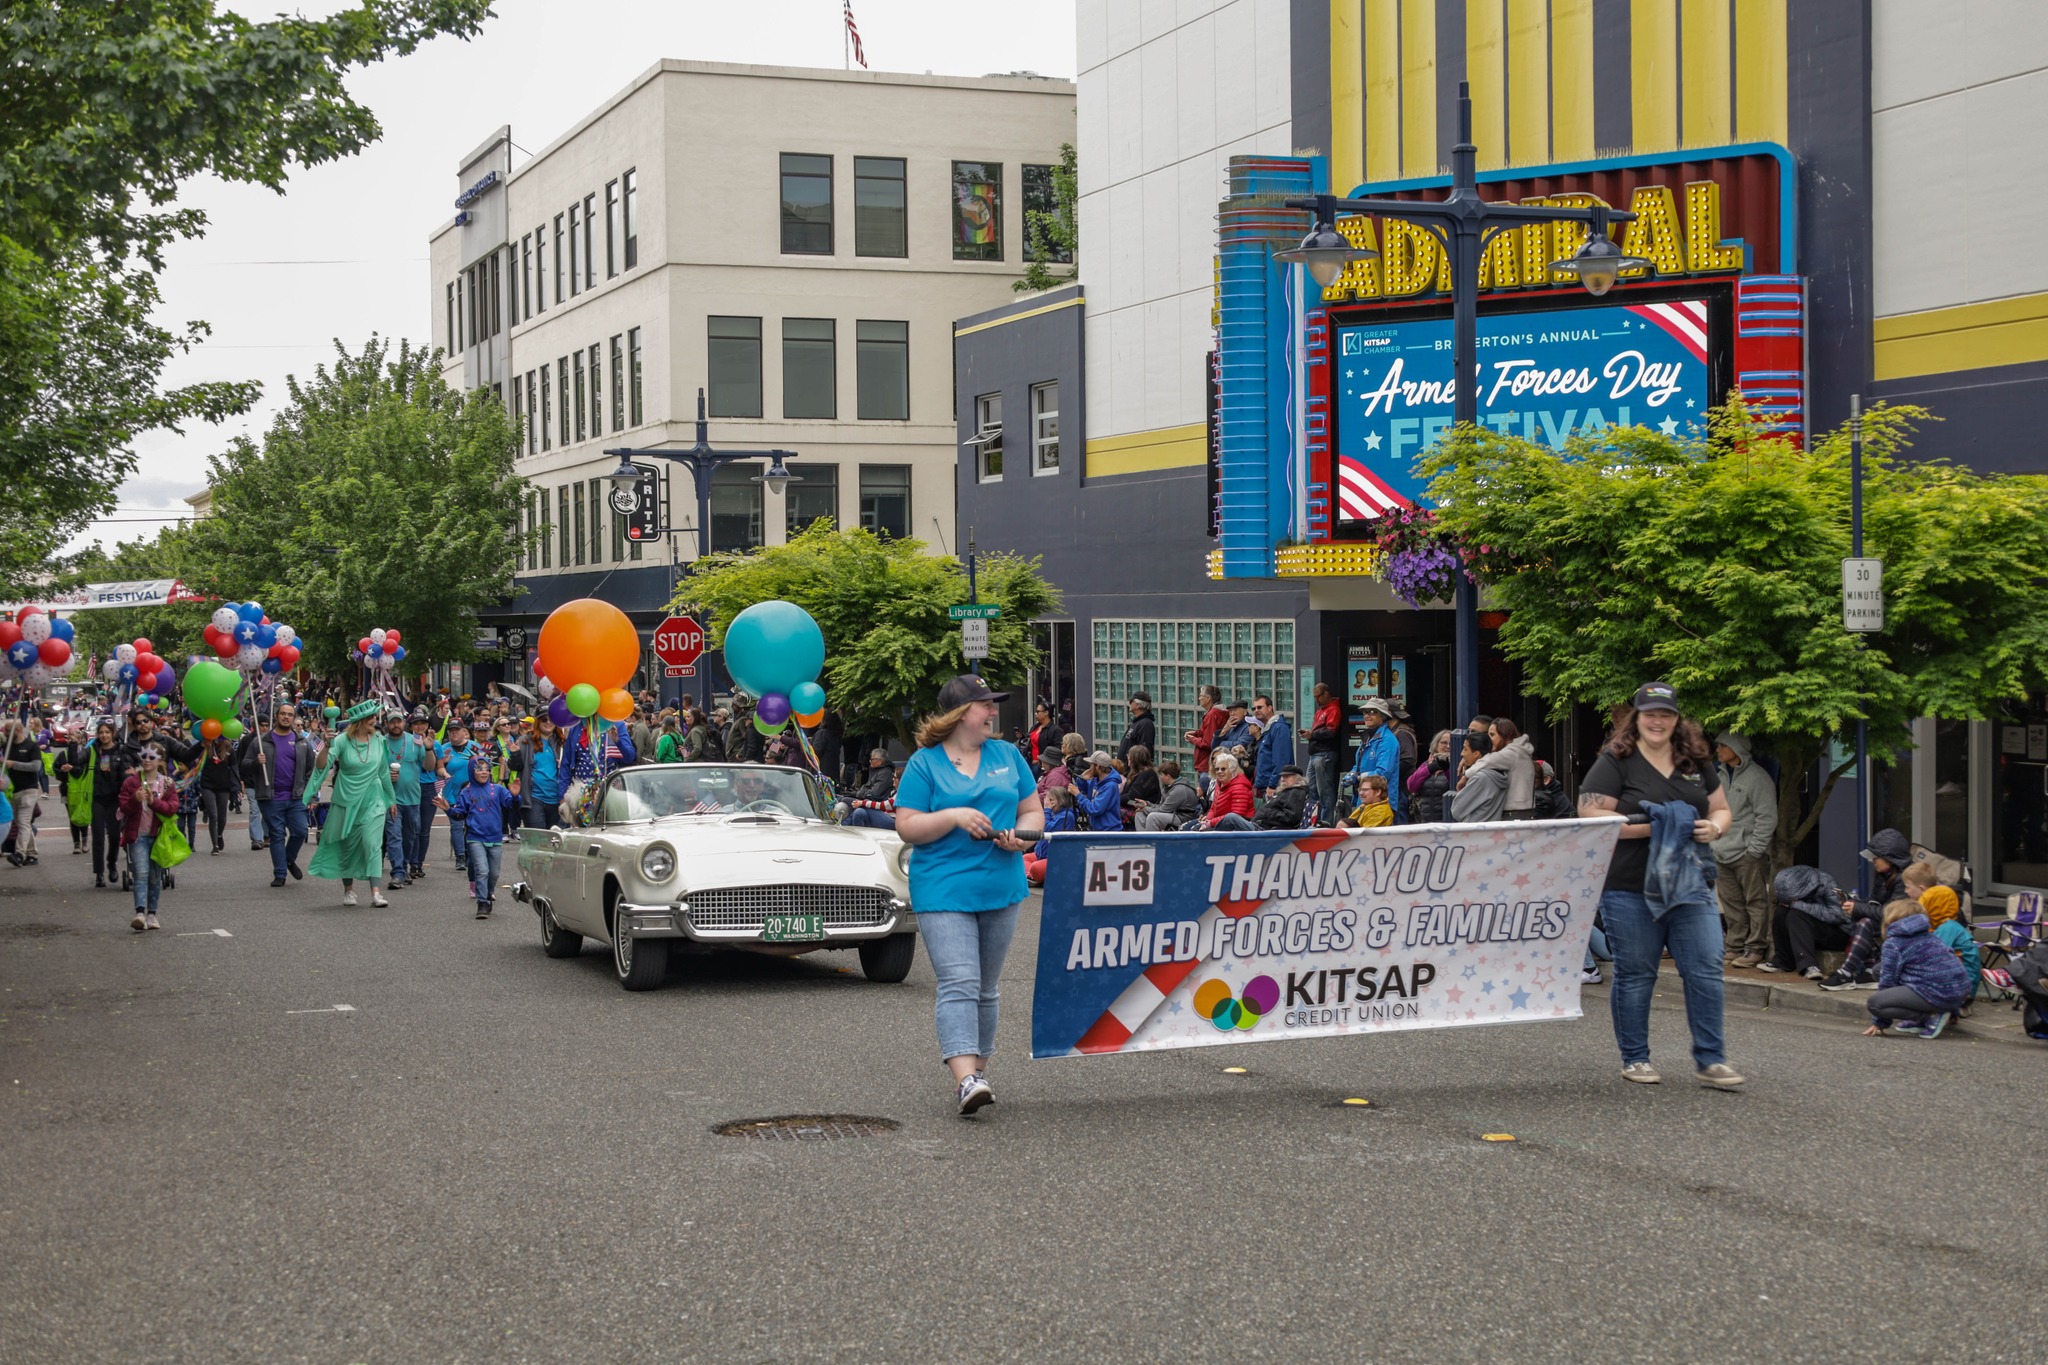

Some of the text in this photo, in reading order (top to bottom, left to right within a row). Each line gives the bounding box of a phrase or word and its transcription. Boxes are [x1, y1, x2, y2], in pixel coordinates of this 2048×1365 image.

[1364, 329, 1398, 338] GREATER
[1539, 329, 1599, 343] ANNUAL
[1364, 338, 1391, 346] KITSAP
[1364, 346, 1400, 354] CHAMBER
[1360, 350, 1682, 417] Arme Forces Day
[1856, 569, 1870, 581] 30
[98, 591, 161, 603] FESTIVAL
[1847, 591, 1880, 600] MINUTE
[949, 607, 982, 617] Library
[1847, 609, 1881, 618] PARKING
[658, 632, 701, 651] STOP
[1087, 859, 1151, 893] A-13
[1205, 845, 1465, 903] THANK YOU
[813, 917, 820, 932] E
[1065, 900, 1571, 971] ARMED FORCES & FAMILIES
[1286, 963, 1436, 1007] KITSAP
[1285, 1002, 1418, 1026] CREDIT UNION
